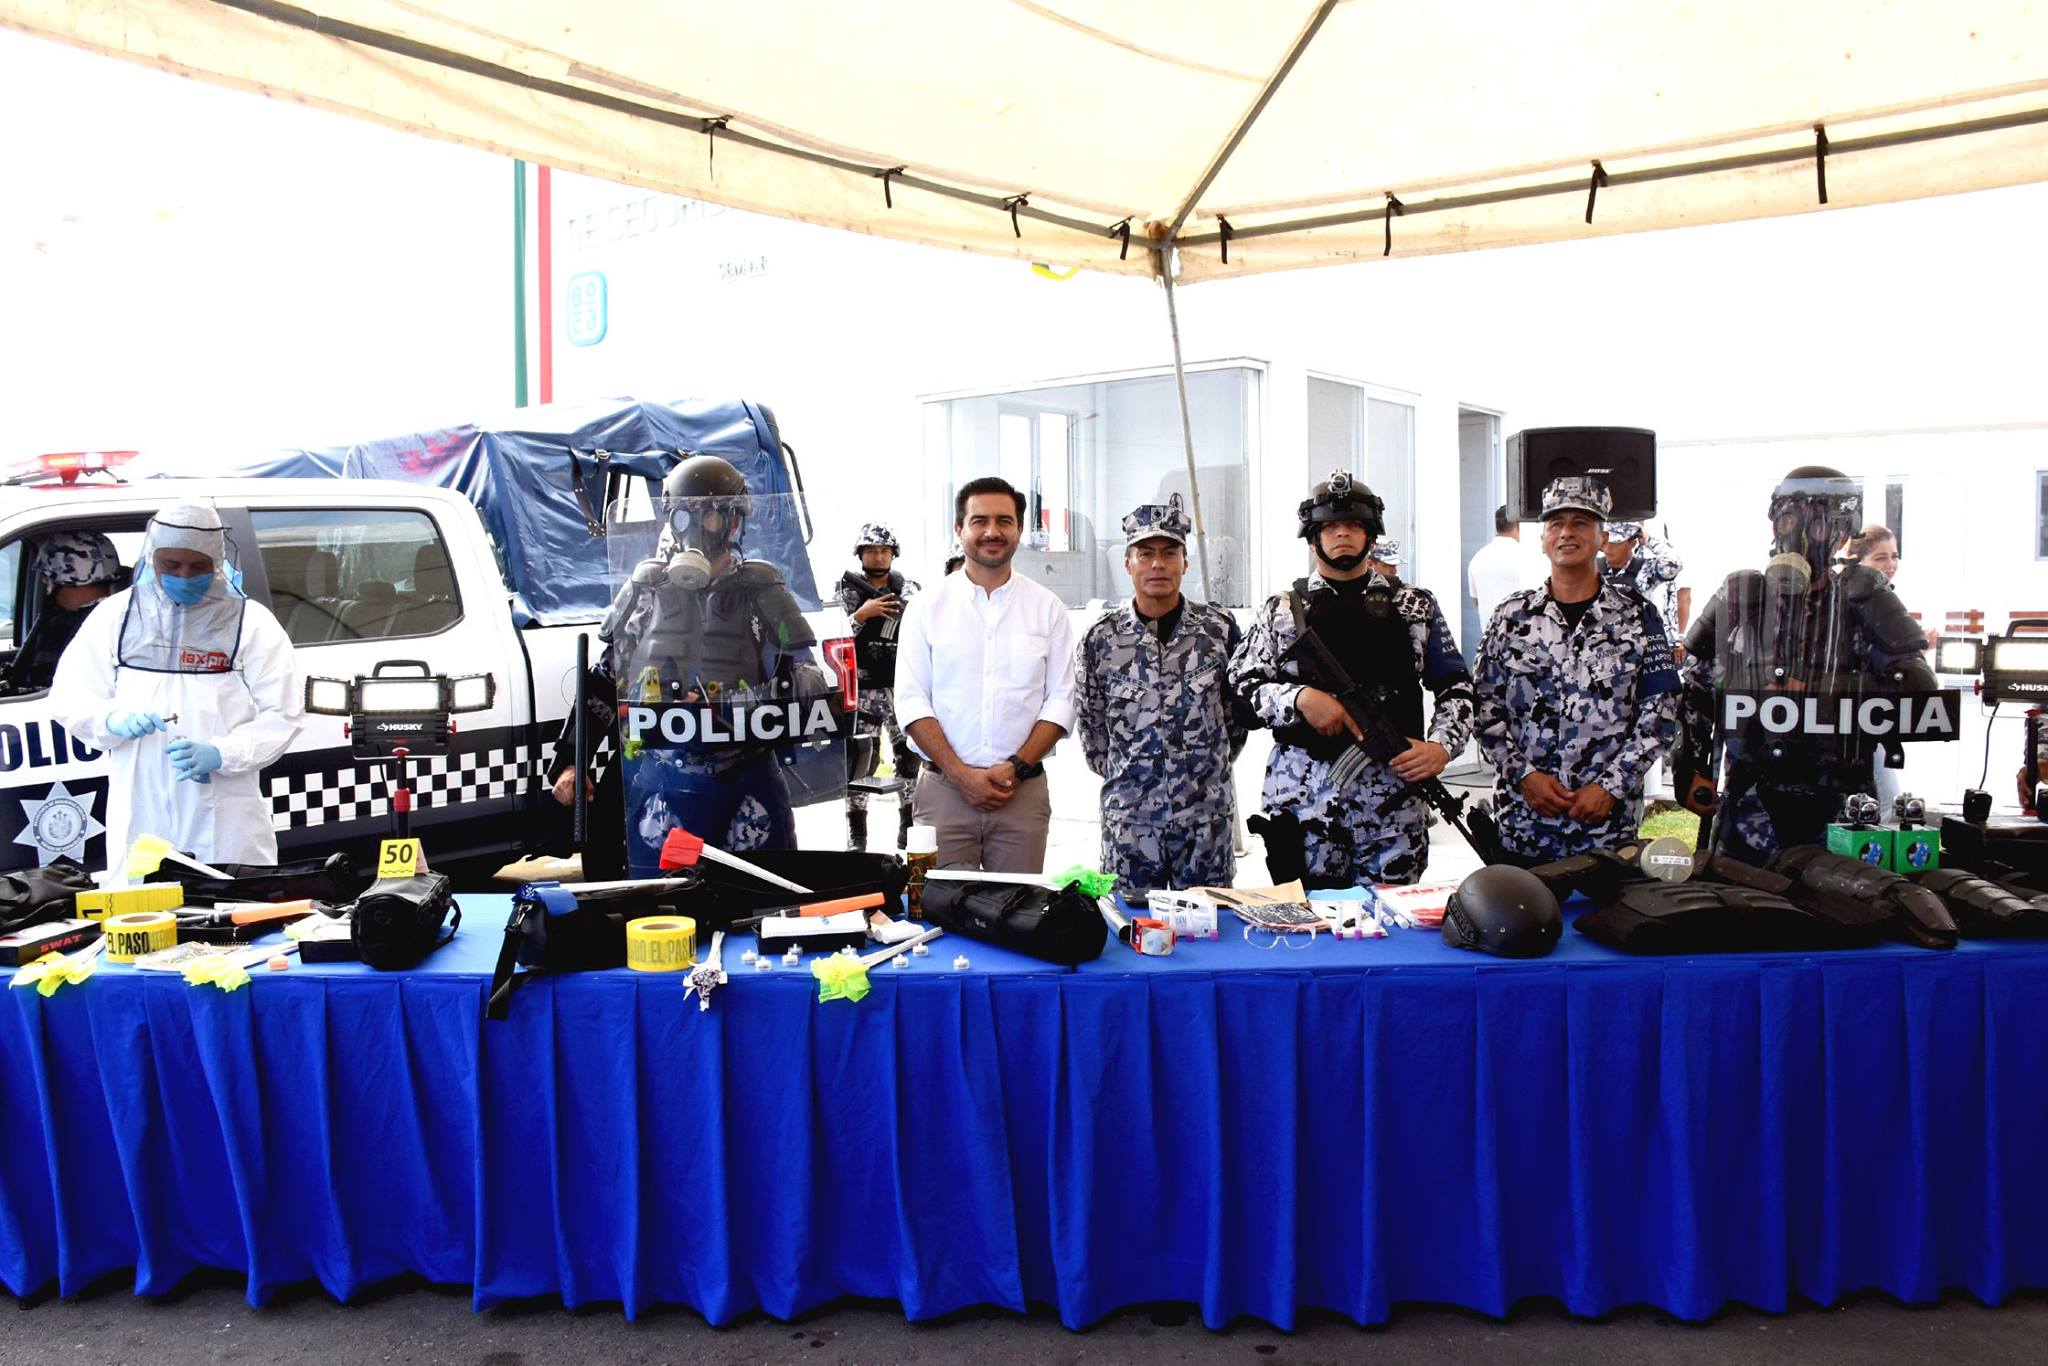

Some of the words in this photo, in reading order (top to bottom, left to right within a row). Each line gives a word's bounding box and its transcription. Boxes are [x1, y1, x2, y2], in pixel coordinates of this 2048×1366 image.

[628, 699, 838, 744] POLICIA
[1725, 695, 1953, 736] POLICIA
[389, 723, 423, 731] HUSKY
[384, 844, 413, 864] 50
[40, 934, 82, 953] SWAT
[667, 937, 688, 962] PAS
